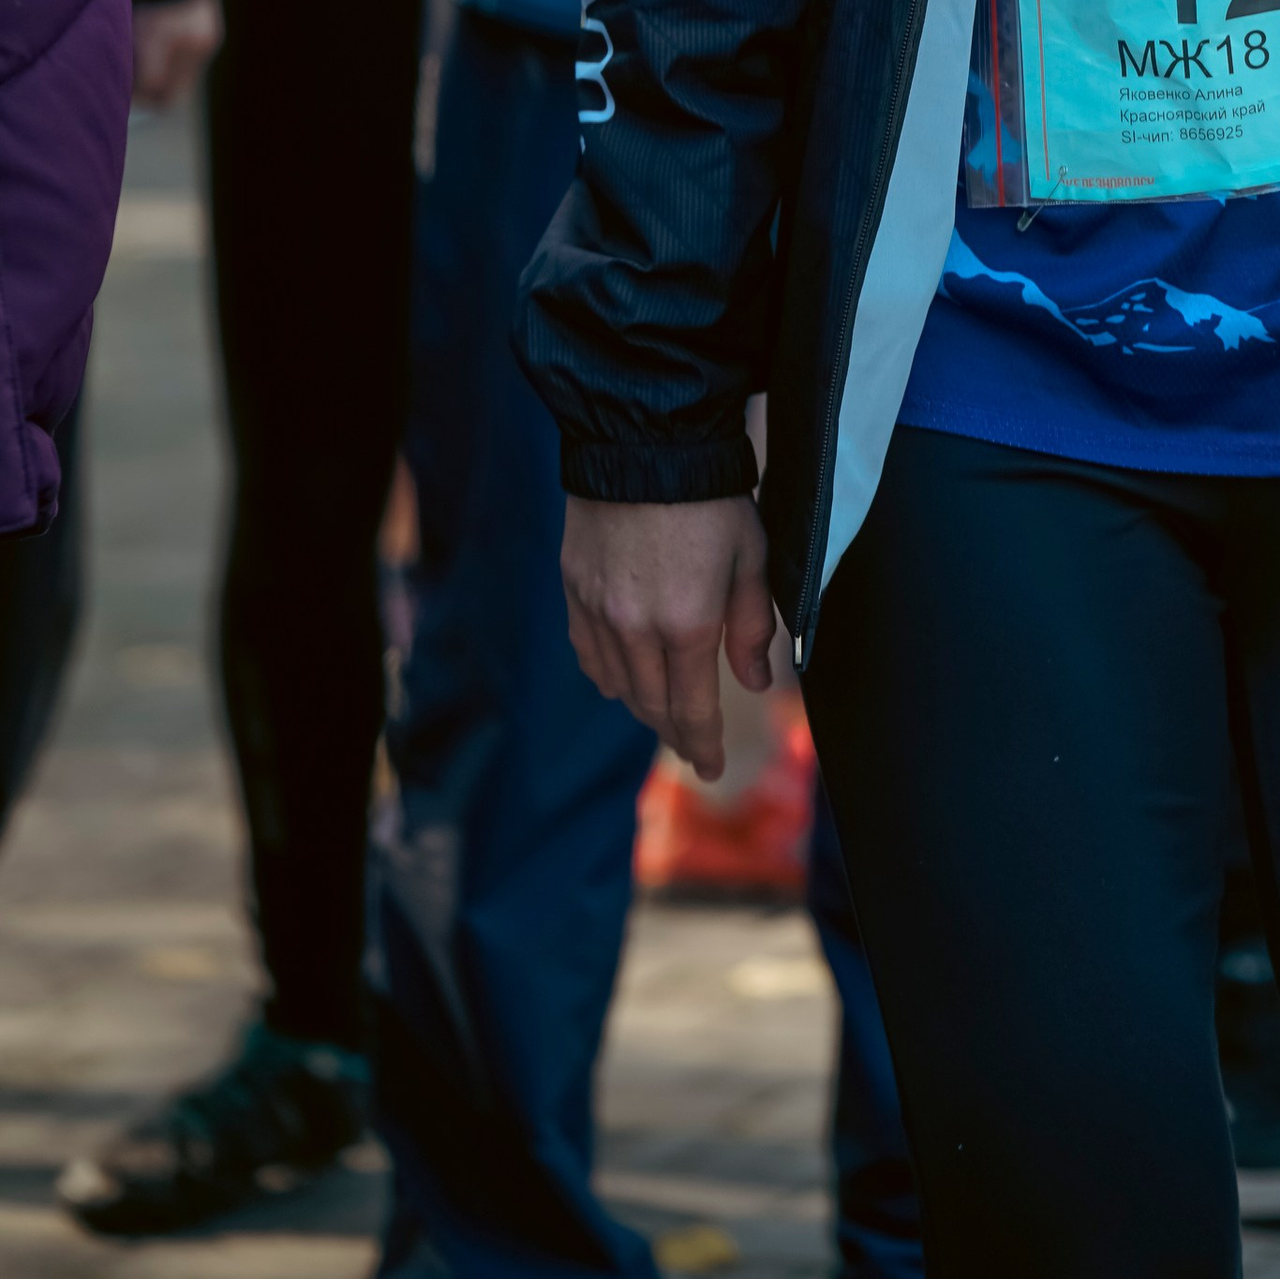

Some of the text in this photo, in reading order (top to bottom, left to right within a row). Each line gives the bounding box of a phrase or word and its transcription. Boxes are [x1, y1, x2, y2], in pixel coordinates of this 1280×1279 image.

[1117, 30, 1270, 79] МЖ18
[1119, 86, 1243, 101] Яковенко Алина
[1120, 100, 1266, 125] Красноярский край
[1179, 125, 1244, 141] 8656925
